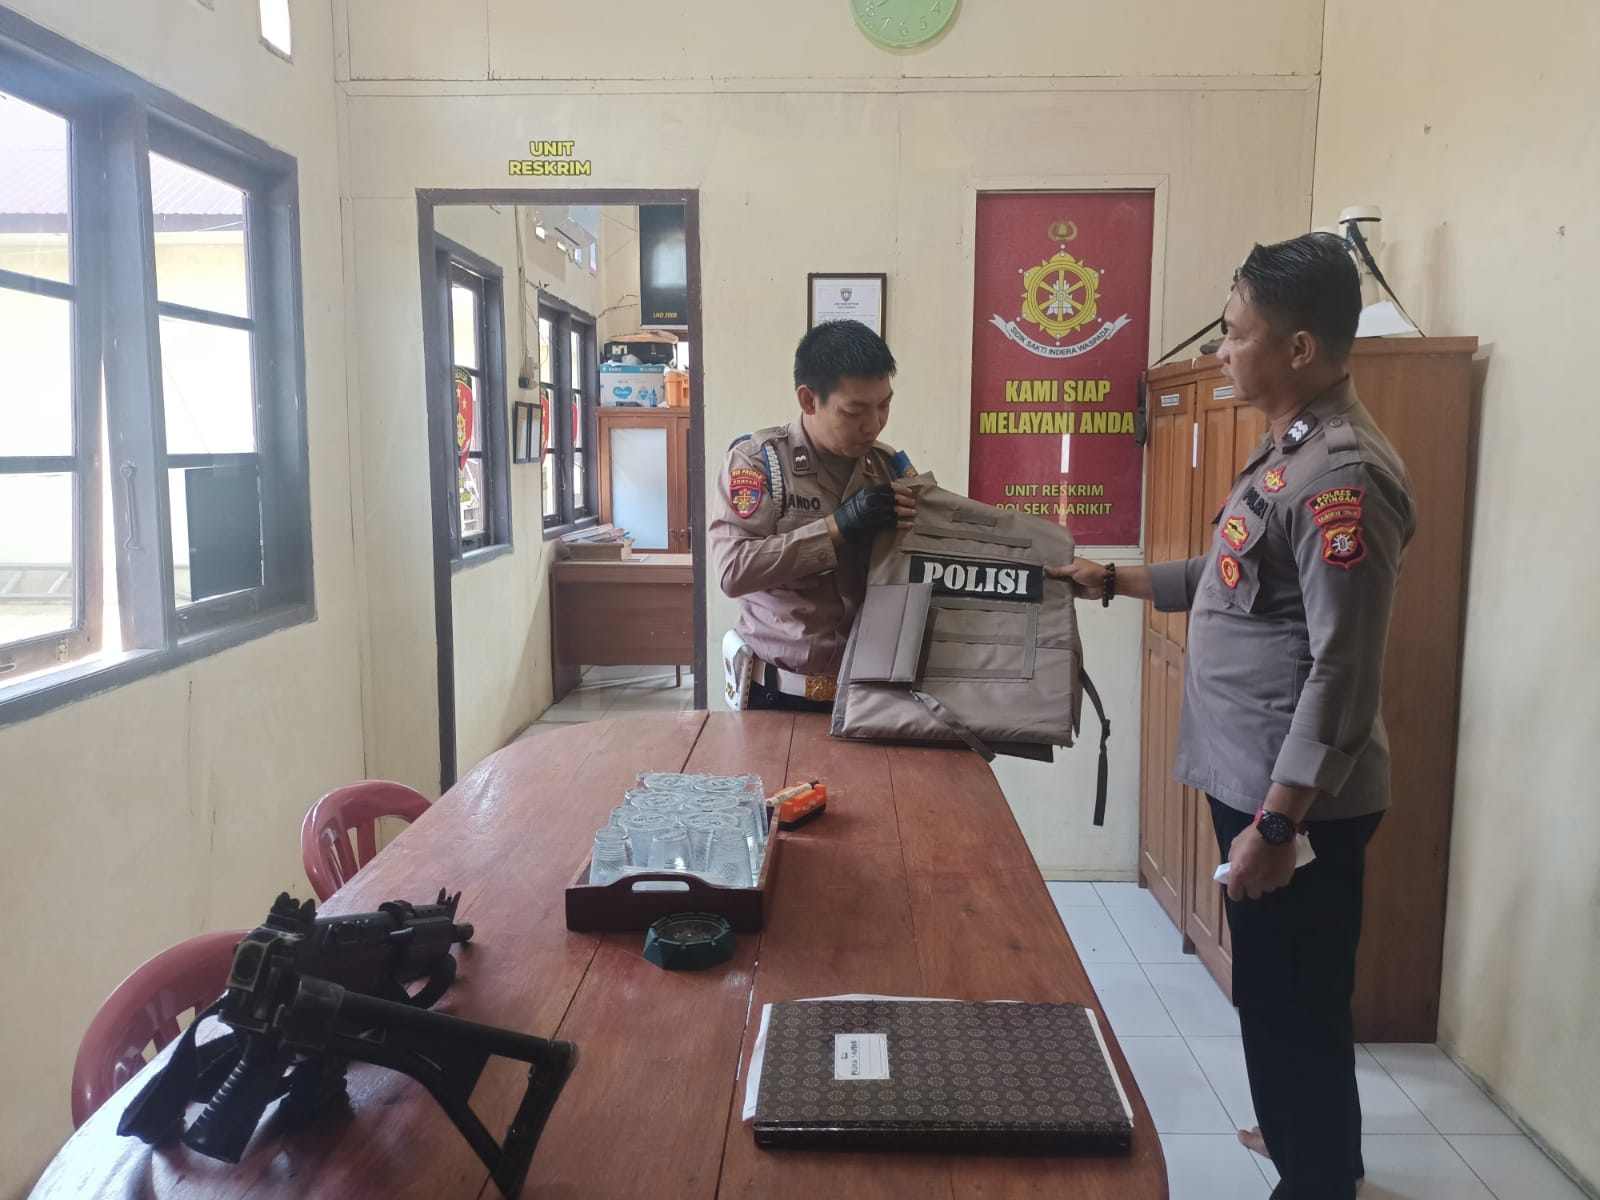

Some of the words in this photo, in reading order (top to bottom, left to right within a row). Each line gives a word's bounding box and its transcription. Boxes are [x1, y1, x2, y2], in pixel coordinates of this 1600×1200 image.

[880, 16, 891, 31] 7
[919, 15, 928, 31] 5
[529, 140, 575, 157] UNIT
[508, 160, 592, 177] RESKRIM
[1010, 326, 1027, 344] SIDIK
[1026, 340, 1047, 355] SAKTI
[1048, 347, 1078, 357] INDERA
[1078, 326, 1111, 353] WASPADA
[1004, 379, 1059, 403] KAMI
[1062, 379, 1112, 403] SIAP
[978, 411, 1076, 434] MELAYANI
[1079, 411, 1136, 434] ANDA
[1004, 484, 1040, 497] UNIT
[1042, 484, 1105, 497] RESKRIM
[1316, 489, 1352, 504] POLRES
[1053, 503, 1114, 515] MARIKIT
[1243, 486, 1269, 520] POLRI
[922, 561, 1030, 595] POLISI
